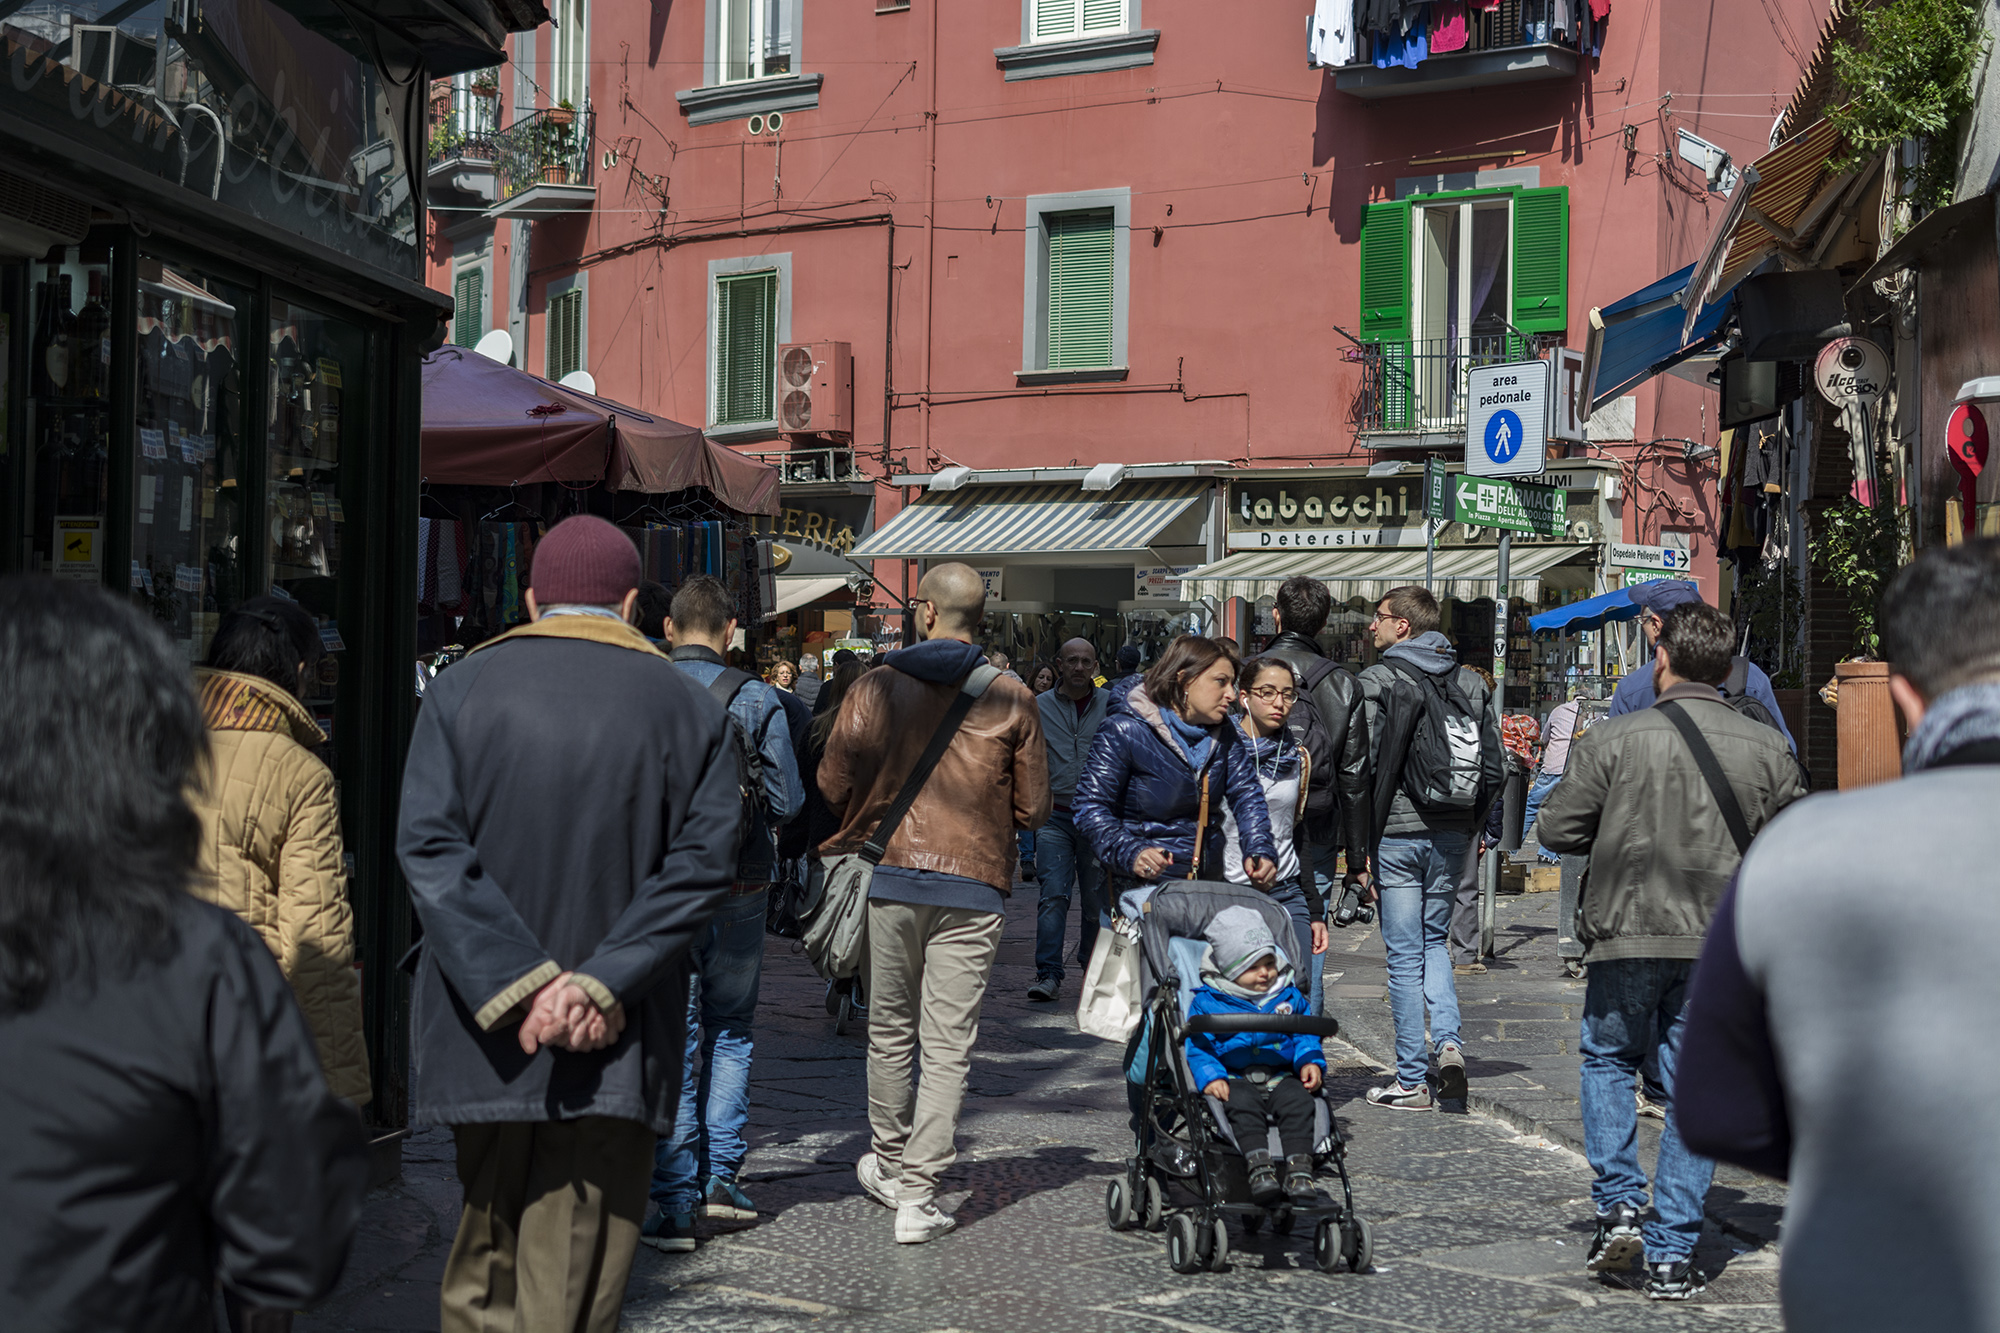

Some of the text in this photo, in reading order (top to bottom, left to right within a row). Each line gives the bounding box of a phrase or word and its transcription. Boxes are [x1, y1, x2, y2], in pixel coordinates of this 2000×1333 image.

[1493, 376, 1517, 387] area
[1826, 373, 1855, 388] ilco
[1845, 383, 1878, 395] ORION
[1480, 389, 1531, 408] pedonale
[1241, 486, 1408, 520] tabacchi
[1498, 486, 1564, 513] FARMACIA
[1475, 513, 1491, 521] Piazza
[1498, 516, 1515, 526] Aperta
[1516, 518, 1529, 527] dalle
[1498, 506, 1564, 524] DELL' ADDOLORATA
[1261, 530, 1383, 547] Detersivi
[1613, 547, 1660, 562] Ospedale Pellegrini
[1444, 715, 1481, 800] NIKE
